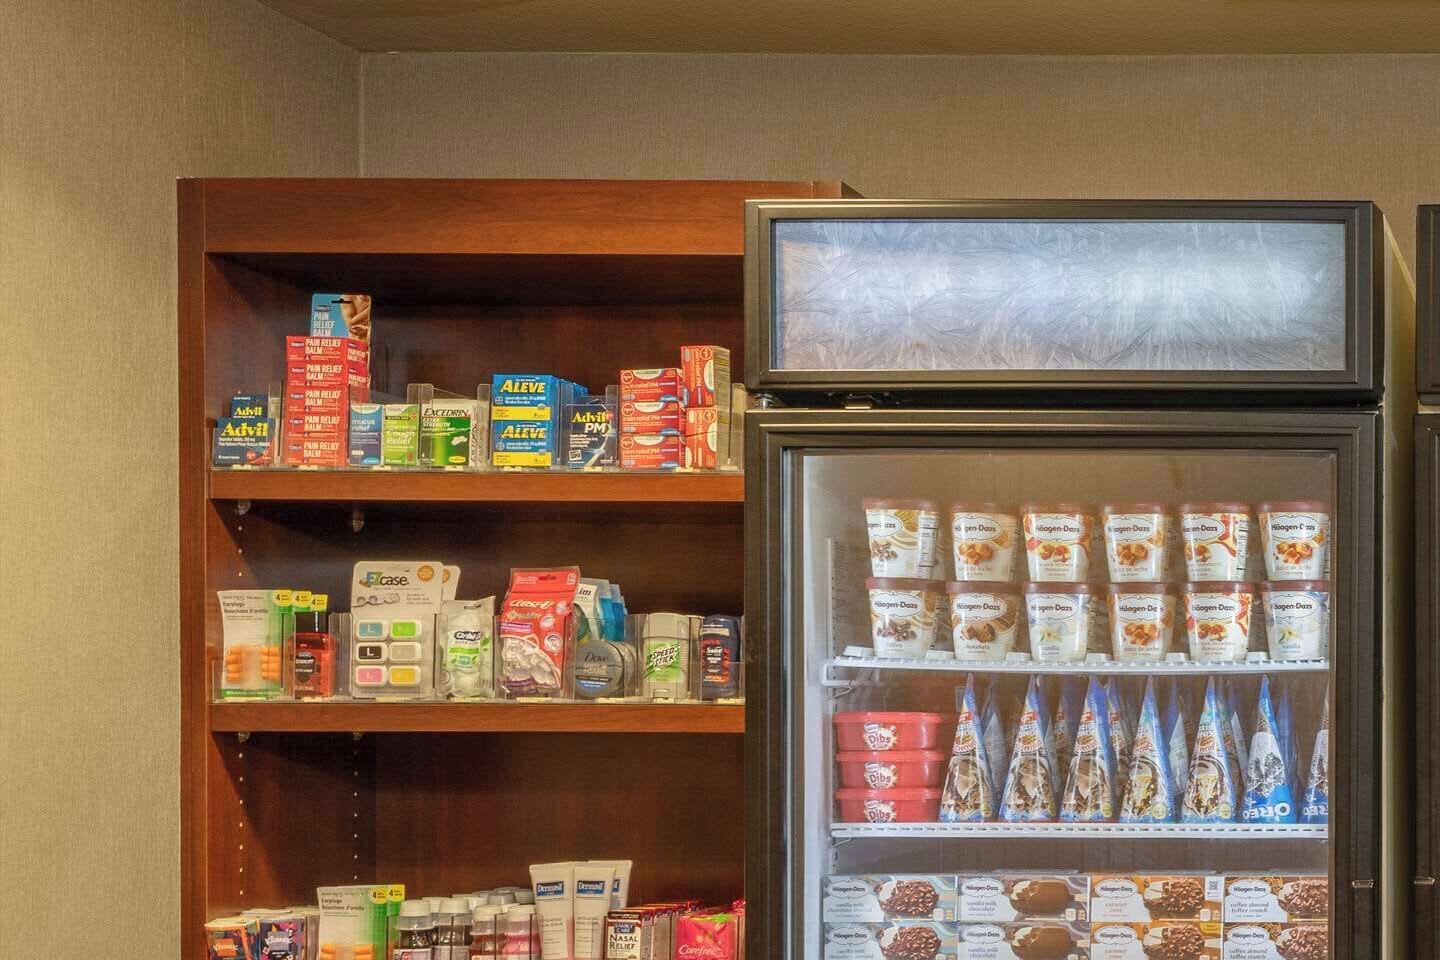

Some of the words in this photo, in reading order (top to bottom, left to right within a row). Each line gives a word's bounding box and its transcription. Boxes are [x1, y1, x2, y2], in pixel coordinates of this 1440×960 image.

[306, 339, 320, 347] PAIN
[322, 339, 341, 347] RELIEF
[306, 365, 320, 373] PAIN
[322, 365, 342, 373] RELIEF
[500, 380, 545, 392] ALEVE
[234, 407, 263, 416] Advil
[424, 408, 469, 416] EXCEDRIN
[305, 416, 319, 424] PAIN
[321, 416, 340, 424] RELIEF
[572, 412, 606, 422] Advil
[221, 422, 268, 436] Advil
[502, 426, 546, 439] ALEVE
[585, 423, 605, 433] PM
[304, 442, 318, 450] PAIN
[320, 442, 339, 450] RELIEF
[367, 648, 374, 656] L
[869, 733, 890, 744] Dibs
[869, 773, 891, 784] Dibs
[869, 810, 890, 821] Dibs
[610, 934, 638, 942] NASAL
[610, 942, 635, 950] RELIEF
